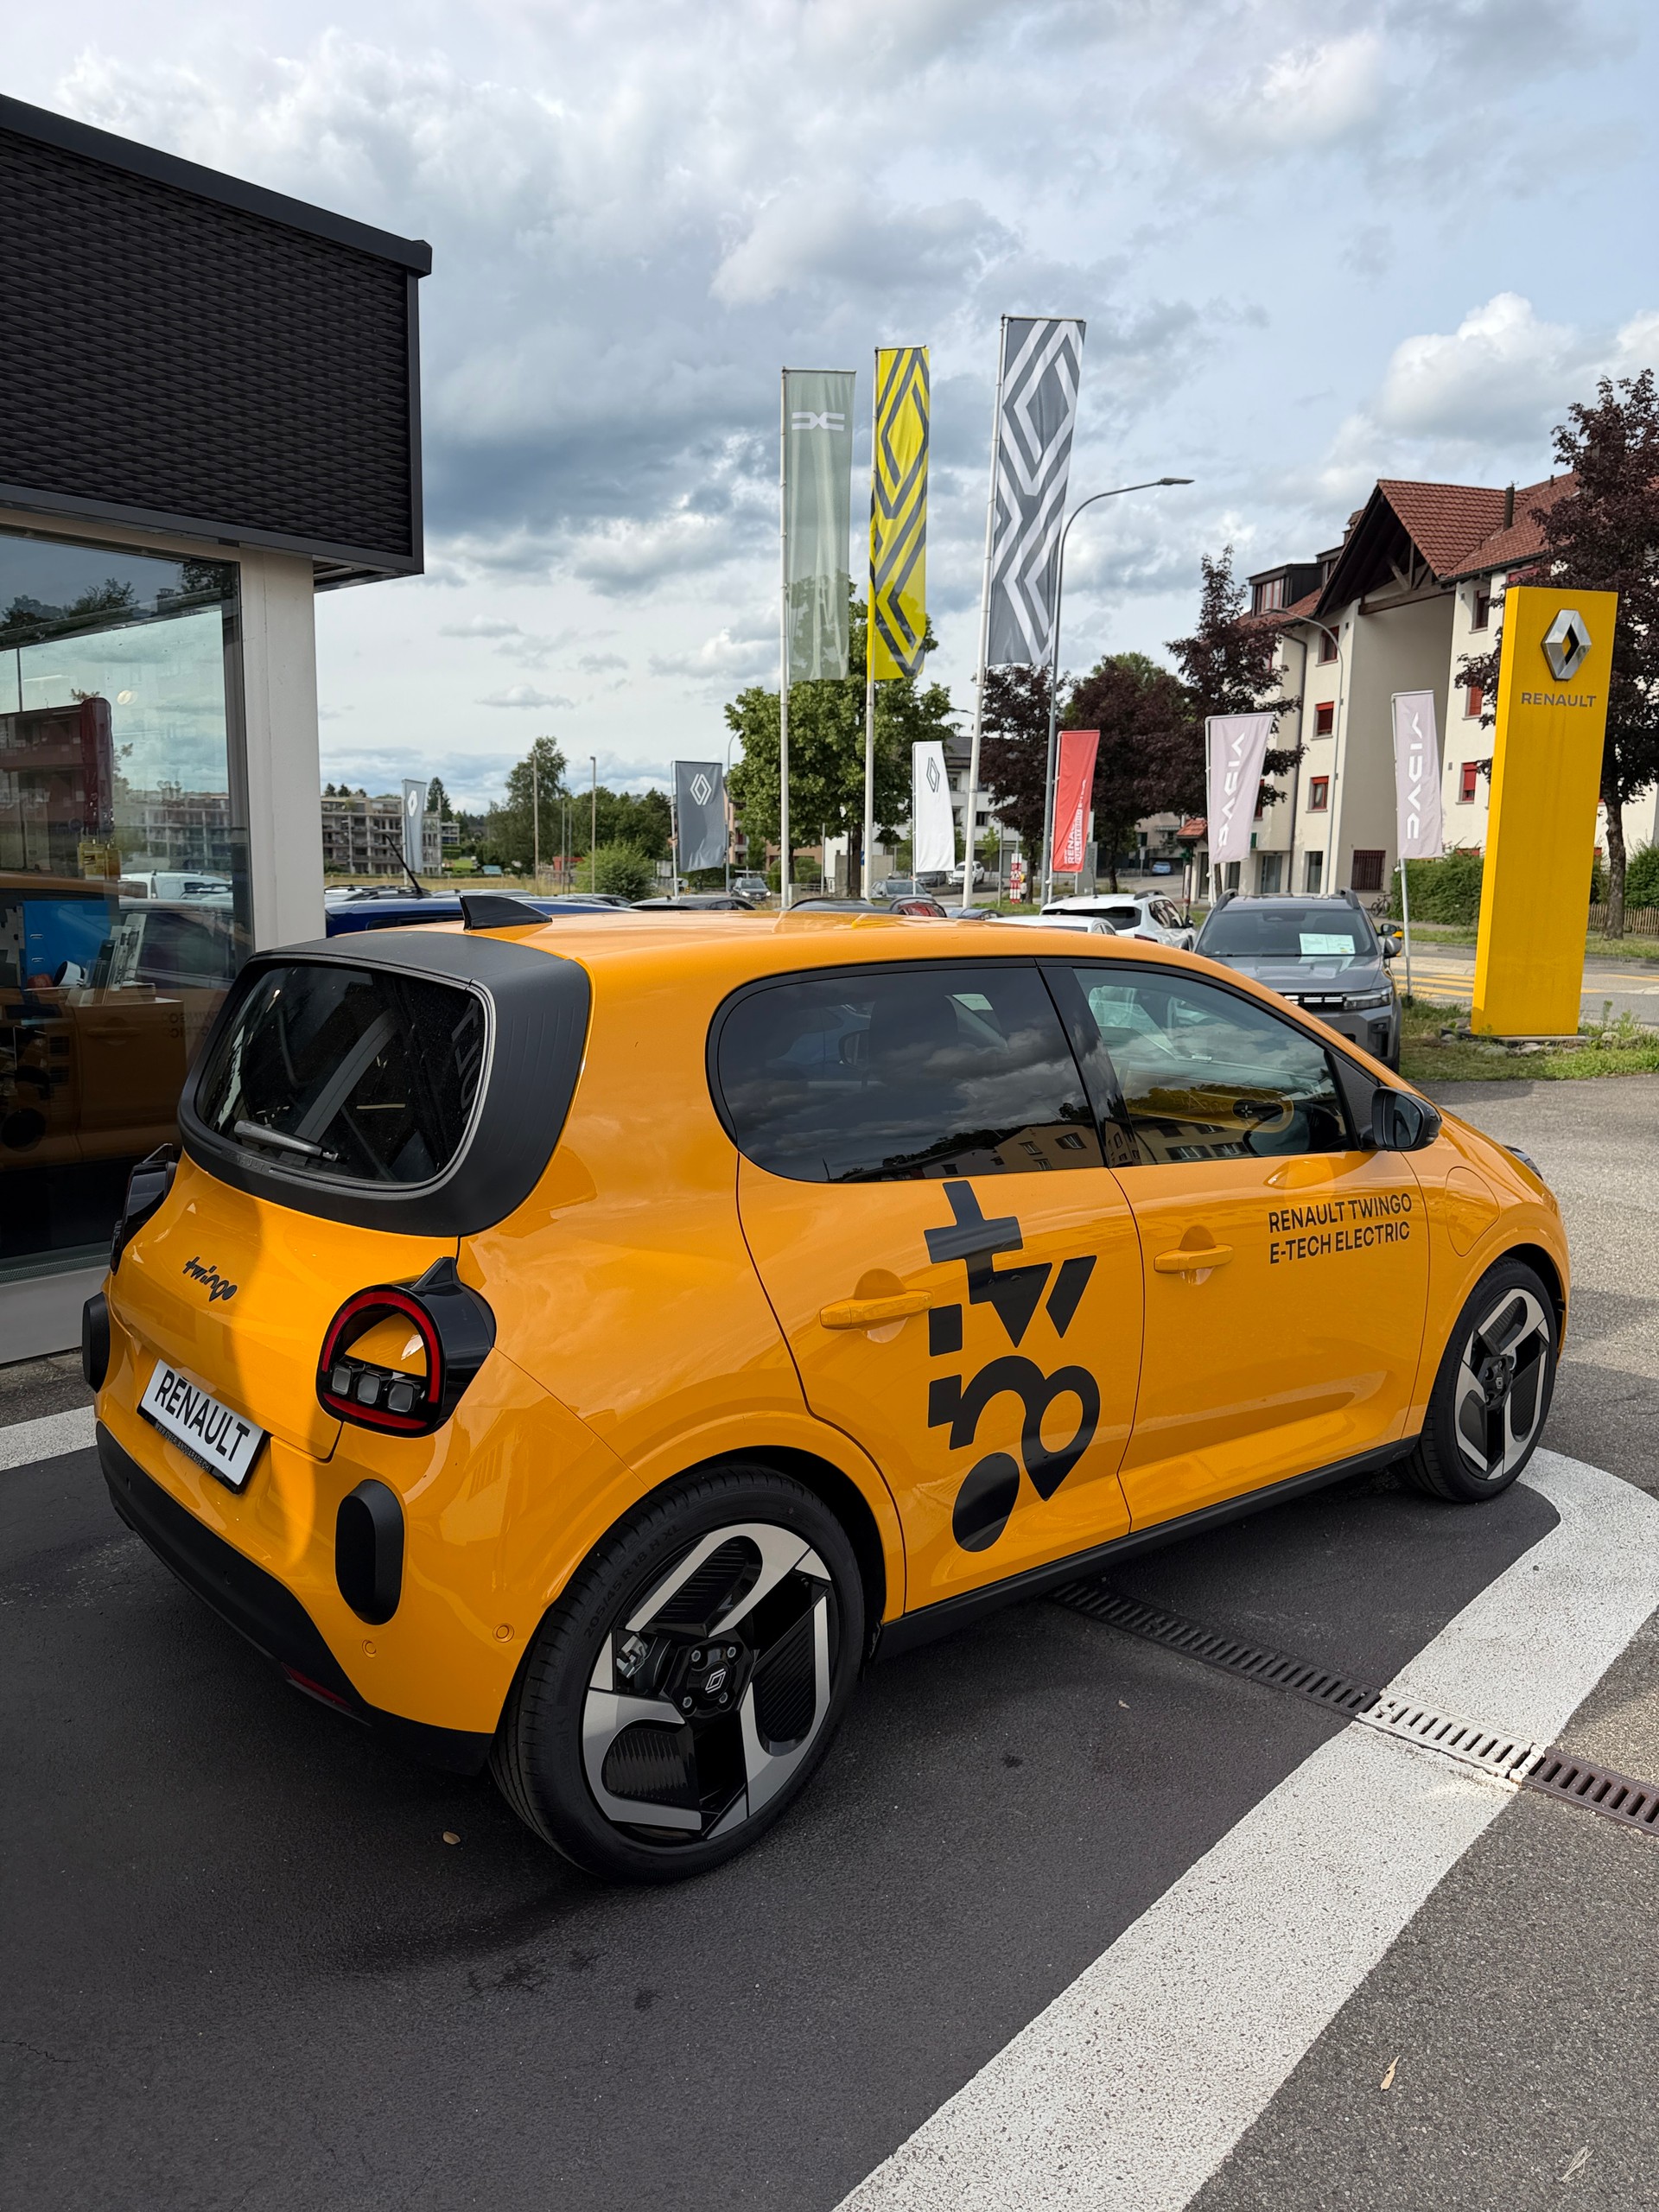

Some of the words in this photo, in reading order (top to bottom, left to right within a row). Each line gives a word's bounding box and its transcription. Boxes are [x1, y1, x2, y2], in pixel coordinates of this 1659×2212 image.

[1521, 692, 1597, 708] RENAULT
[1217, 732, 1246, 848] DACIA
[1407, 711, 1423, 840] DACIA
[1268, 1201, 1344, 1233] RENAULT
[1348, 1193, 1412, 1220] TWINGO
[1270, 1233, 1332, 1264] E-TECH
[1335, 1221, 1410, 1252] ELECTRIC
[182, 1255, 238, 1302] twingo
[154, 1369, 251, 1462] RENAULT
